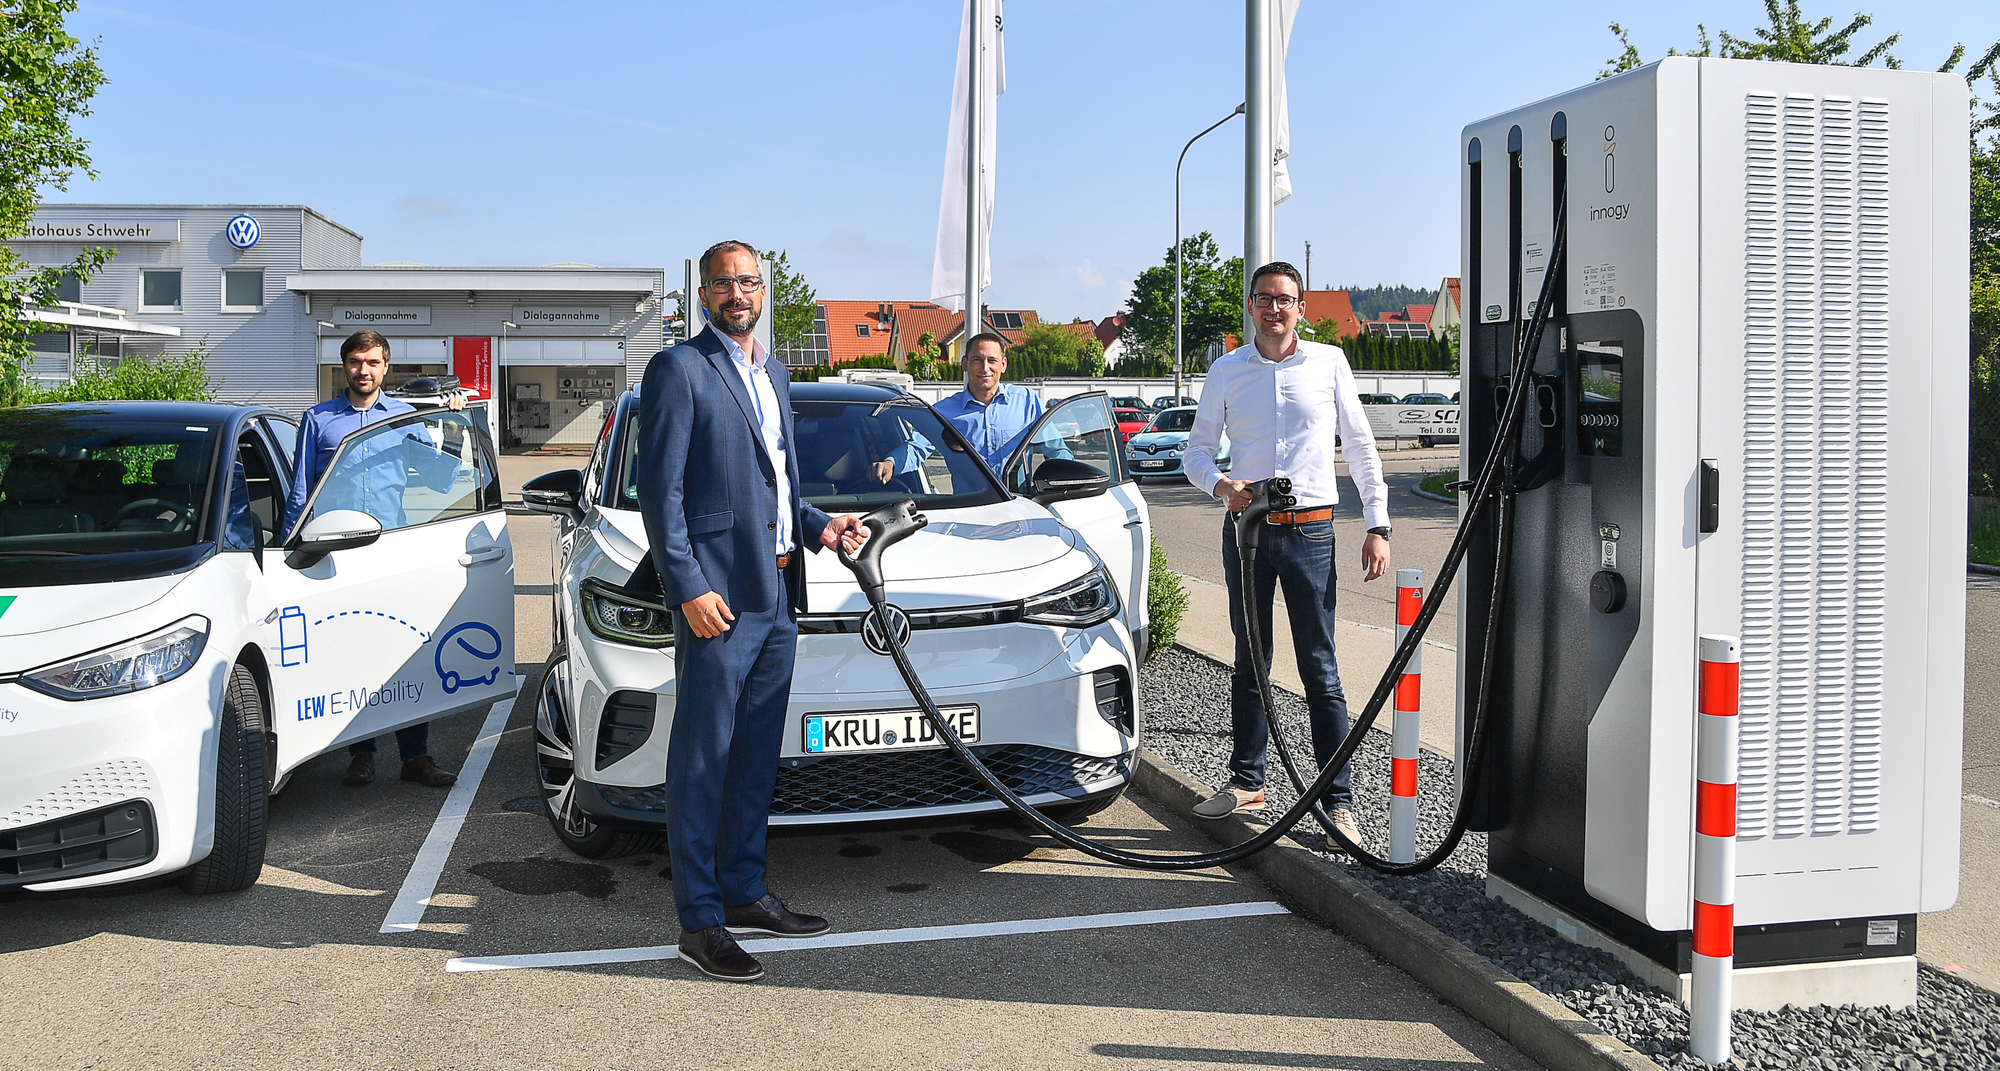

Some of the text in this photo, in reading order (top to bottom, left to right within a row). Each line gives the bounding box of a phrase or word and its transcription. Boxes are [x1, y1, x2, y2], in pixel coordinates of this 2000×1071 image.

[1590, 202, 1631, 221] innogy
[23, 223, 152, 237] utohaus Schwehr
[345, 310, 418, 322] Dialogannahme
[523, 310, 600, 322] Dialogannahme
[617, 341, 624, 350] 2
[297, 680, 424, 721] LEW E-Mobility
[824, 718, 880, 748] KRU
[812, 738, 818, 747] D
